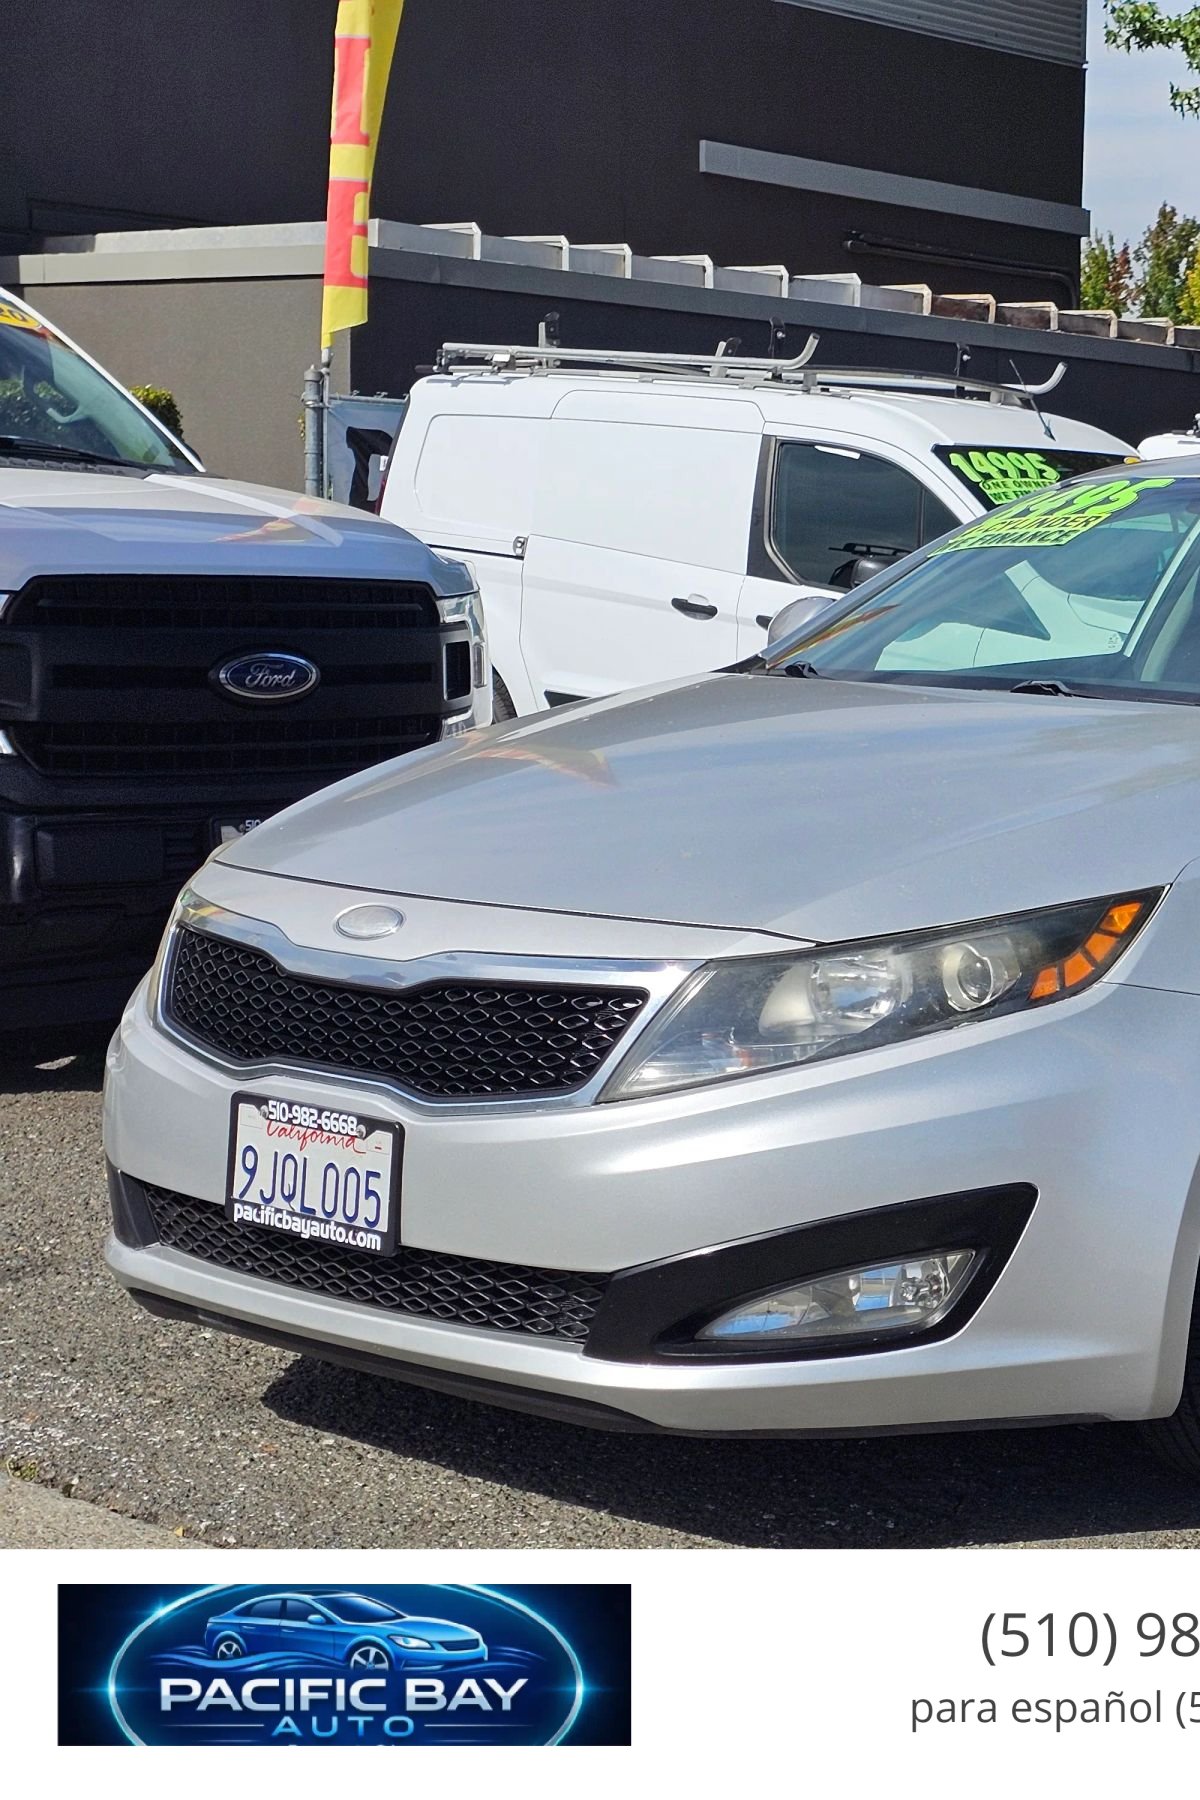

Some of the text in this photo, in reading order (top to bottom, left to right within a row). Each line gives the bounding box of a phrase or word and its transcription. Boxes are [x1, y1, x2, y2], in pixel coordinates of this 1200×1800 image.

[949, 451, 1060, 482] 14995
[982, 480, 1010, 490] ONE
[989, 491, 1012, 502] WE
[968, 529, 1081, 547] FINANCE
[245, 662, 297, 688] Ford
[267, 1099, 359, 1137] 510-982-6668
[266, 1119, 367, 1154] California
[238, 1144, 381, 1229] 9JQL005
[233, 1203, 381, 1251] pacificbayauto.com
